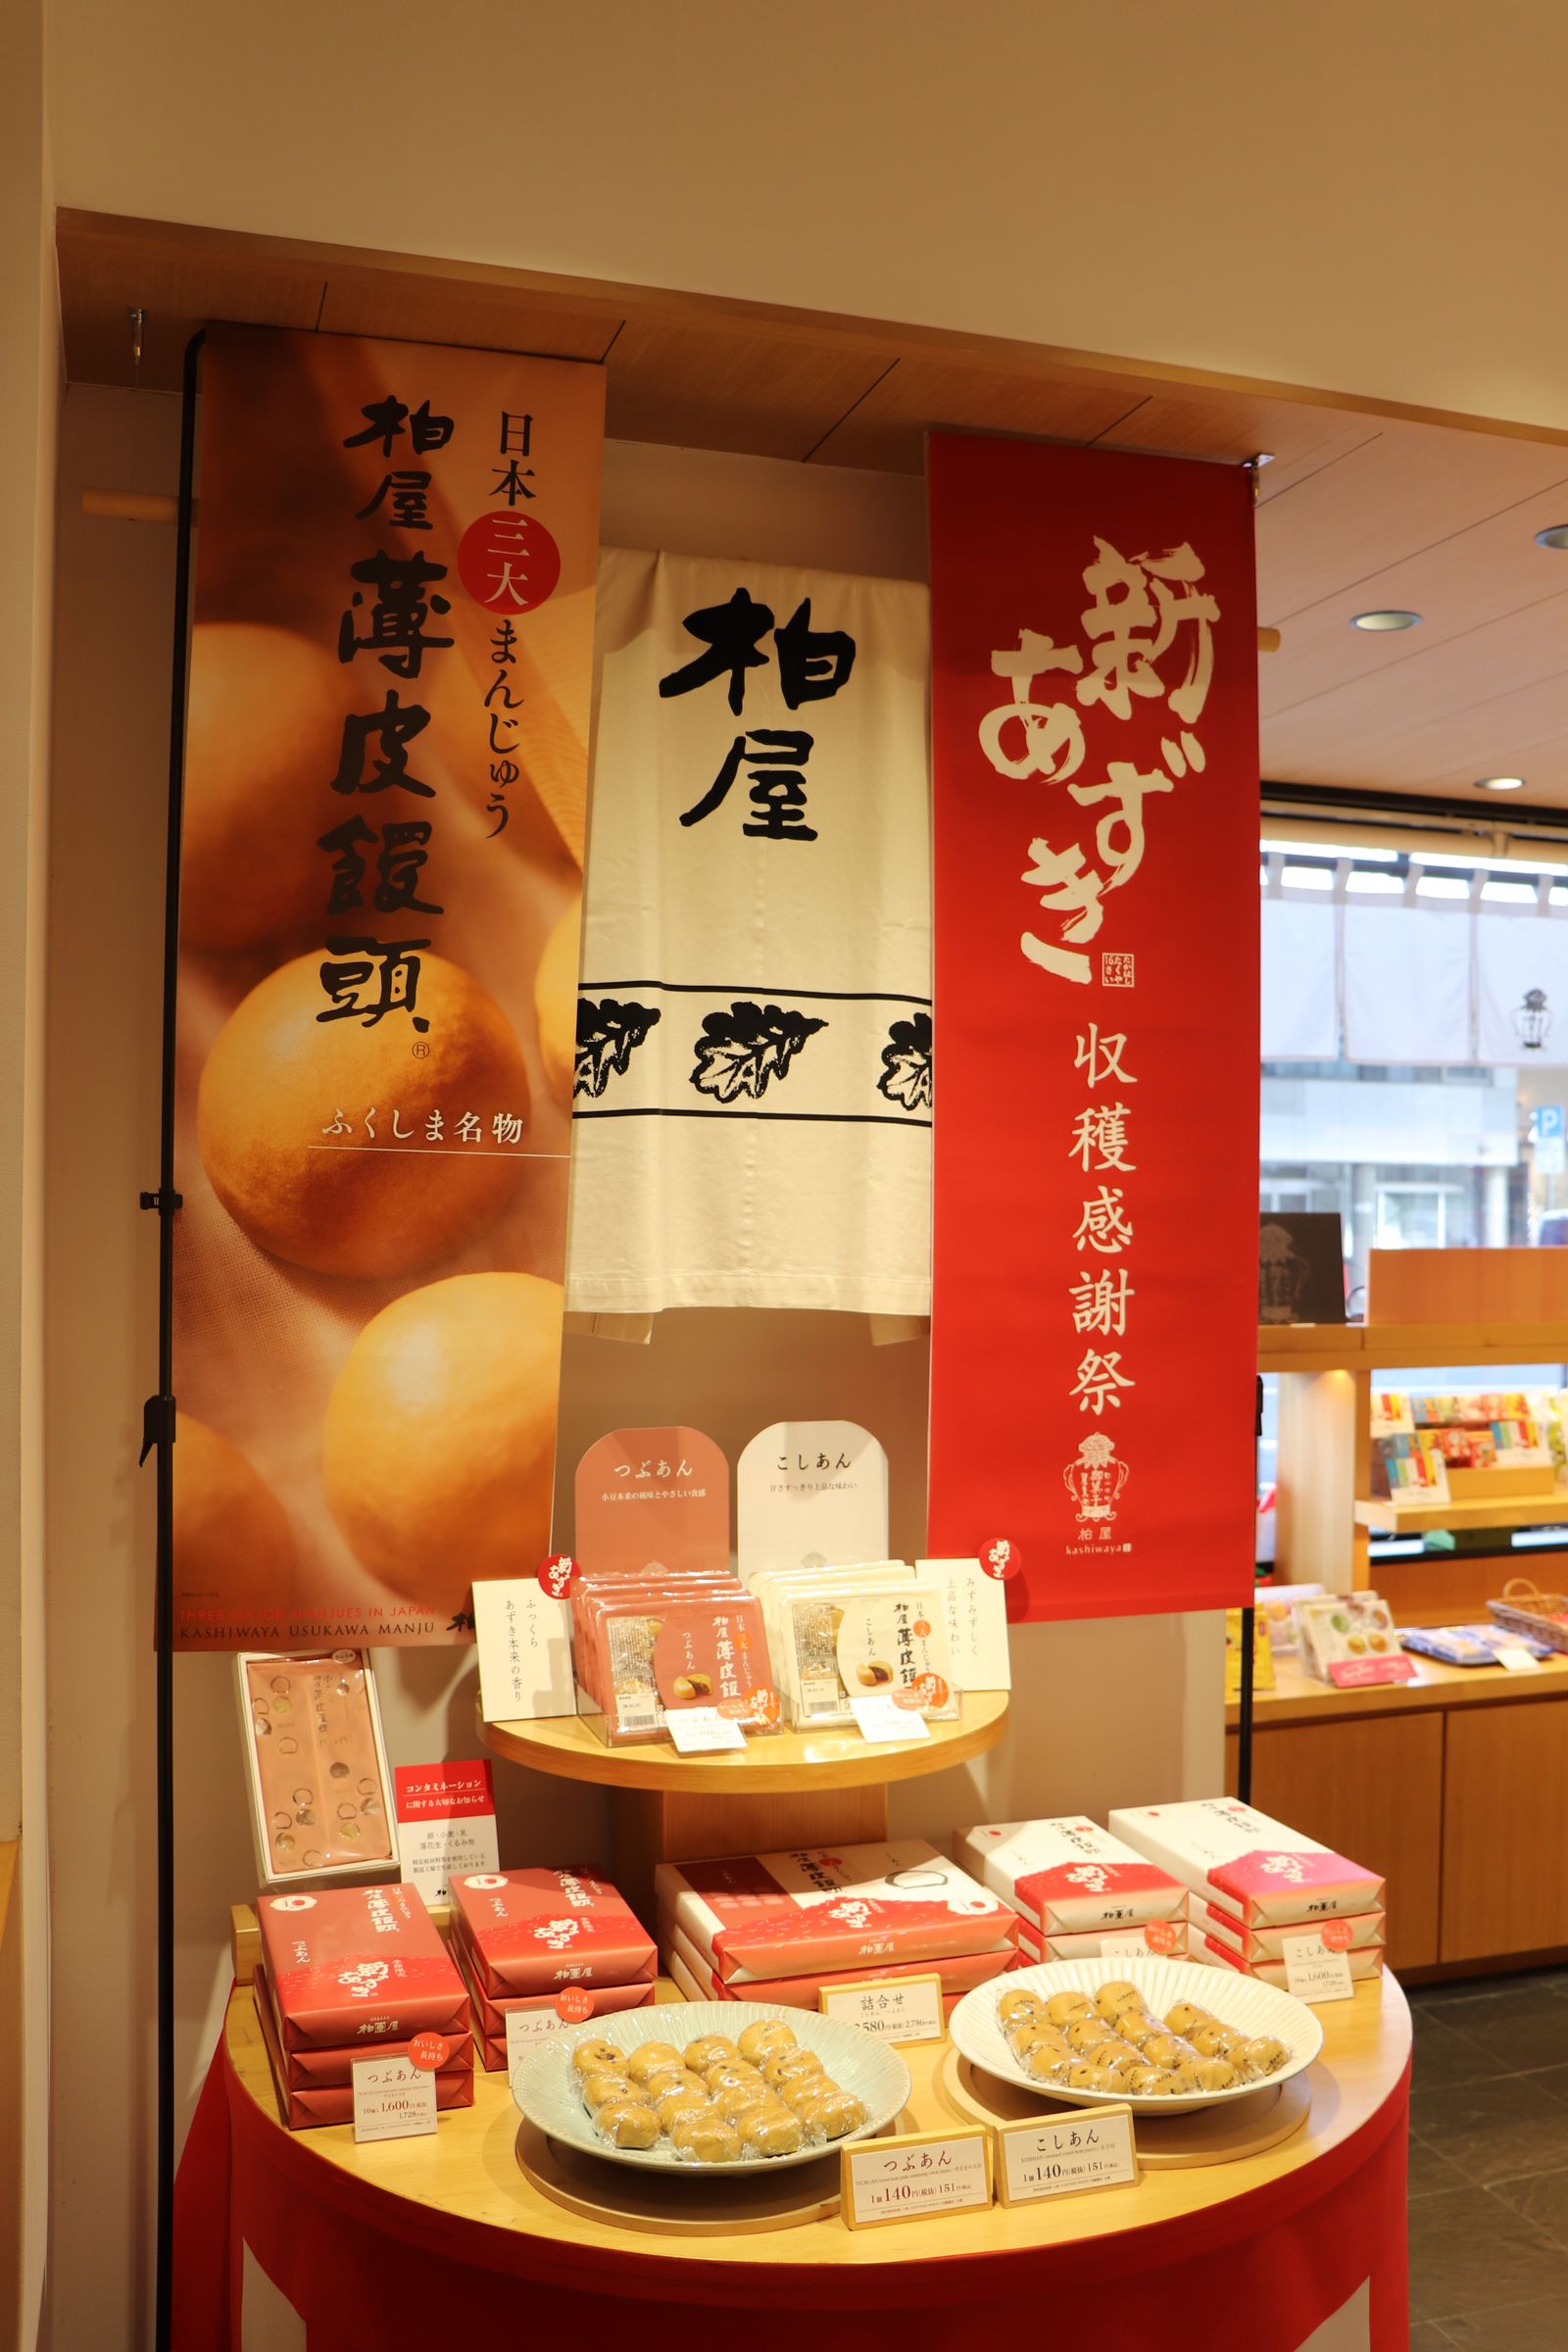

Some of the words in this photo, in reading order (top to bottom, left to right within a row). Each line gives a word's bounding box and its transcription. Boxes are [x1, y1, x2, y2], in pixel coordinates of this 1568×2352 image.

[483, 411, 535, 839] 日本三大まんじゅう
[659, 587, 857, 842] 柏屋
[321, 1107, 523, 1144] ふくしま名物
[1068, 1022, 1137, 1416] 収穫感謝祭
[614, 1458, 693, 1479] つぶあん
[777, 1452, 851, 1471] こしあん
[1077, 1526, 1111, 1541] 柏屋
[1065, 1544, 1121, 1555] kashiwaya
[368, 1607, 383, 1617] IN
[391, 1605, 436, 1617] JAPAN
[946, 1577, 960, 1655] 上品な味わい
[966, 1578, 978, 1655] みずみずしく
[180, 1626, 280, 1640] KASHIWAYA
[289, 1624, 369, 1638] USUKAWA
[378, 1622, 435, 1635] MANJU
[525, 1599, 539, 1647] ふっくら
[505, 1599, 523, 1702] あずき本来の香り
[711, 1615, 742, 1700] 柏屋薄皮饅
[406, 1781, 482, 1793] コンタミネーション
[405, 1795, 485, 1810] に関する大切なお知らせ
[1296, 1944, 1336, 1958] こしあ
[560, 1993, 589, 2004] おいしさ
[859, 1993, 906, 2011] 詰合せ
[414, 2038, 444, 2050] おいしさ
[419, 2050, 444, 2062] 長持ち
[368, 2069, 422, 2084] つぶあん
[1036, 2129, 1100, 2152] こしあん
[883, 2149, 952, 2173] つぶあん
